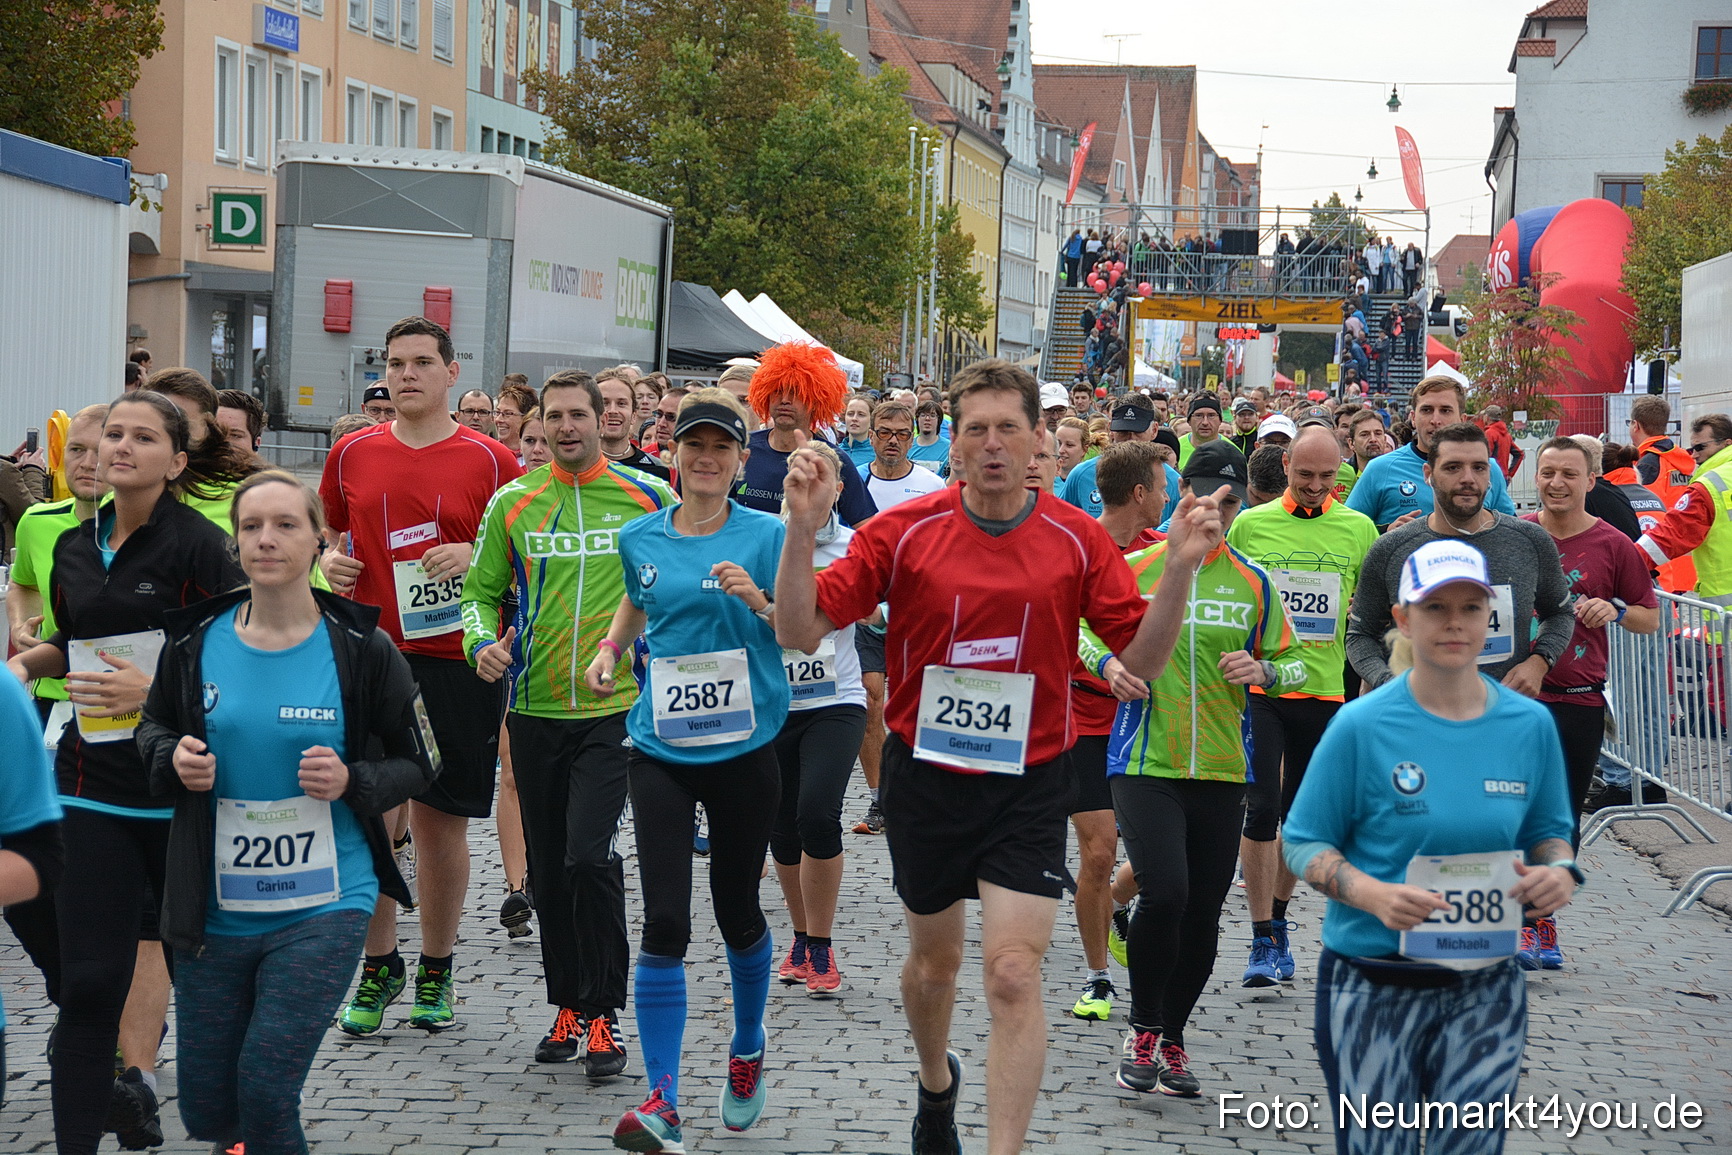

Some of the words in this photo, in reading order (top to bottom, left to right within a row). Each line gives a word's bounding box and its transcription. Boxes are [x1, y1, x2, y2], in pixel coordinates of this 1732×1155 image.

[221, 201, 257, 238] D
[528, 259, 550, 292] OFFICE
[551, 263, 580, 296] INDUSTRY
[581, 268, 603, 300] LOUNGE
[616, 260, 657, 328] BOCK
[1217, 302, 1262, 320] ZIEL
[456, 352, 474, 360] 1106
[746, 488, 772, 499] GOSSEN
[403, 529, 425, 541] DEHN
[409, 574, 464, 608] 2535
[425, 608, 460, 623] Matthias
[970, 645, 999, 656] DEHN
[686, 661, 719, 673] BOCK
[964, 677, 1002, 688] BOCK
[666, 680, 734, 712] 2587
[280, 706, 337, 721] BOCK
[935, 695, 1012, 733] 2534
[687, 717, 722, 731] Verena
[949, 736, 992, 753] Gerhard
[256, 808, 299, 821] BOCK
[232, 830, 316, 869] 2207
[1450, 863, 1491, 874] BOCK
[256, 879, 297, 893] Carina
[1436, 938, 1490, 950] Michaela
